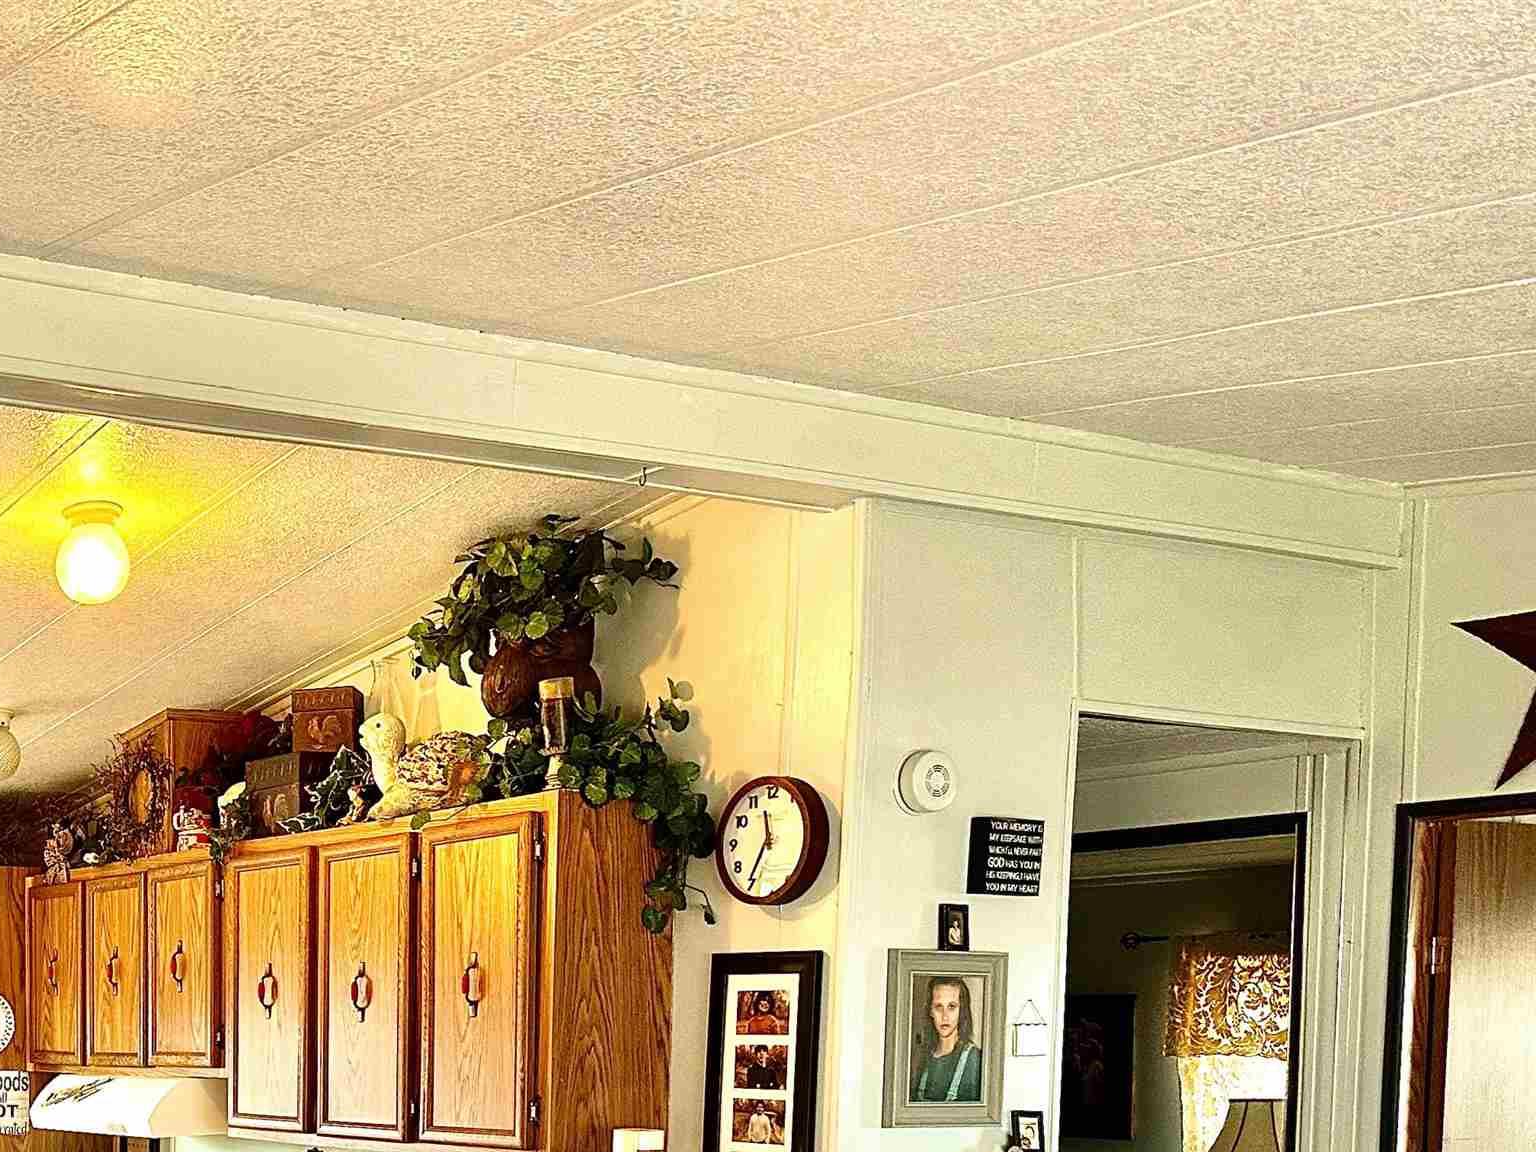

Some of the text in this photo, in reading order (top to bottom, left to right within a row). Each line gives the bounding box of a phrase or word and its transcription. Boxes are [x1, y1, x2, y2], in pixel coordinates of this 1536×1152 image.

[766, 785, 779, 799] 12
[749, 795, 758, 809] 11
[736, 815, 748, 829] 10
[991, 821, 1008, 831] YOUR
[1009, 823, 1036, 832] MEMORY
[989, 833, 999, 841] MY
[729, 839, 738, 852] 9
[734, 861, 742, 873] 8
[987, 856, 1004, 868] GOD
[1005, 860, 1018, 868] HAS
[1020, 861, 1033, 869] YOU
[985, 871, 995, 879] HIS
[985, 882, 999, 891] YOU
[1000, 883, 1007, 891] IN
[1007, 884, 1018, 892] MY
